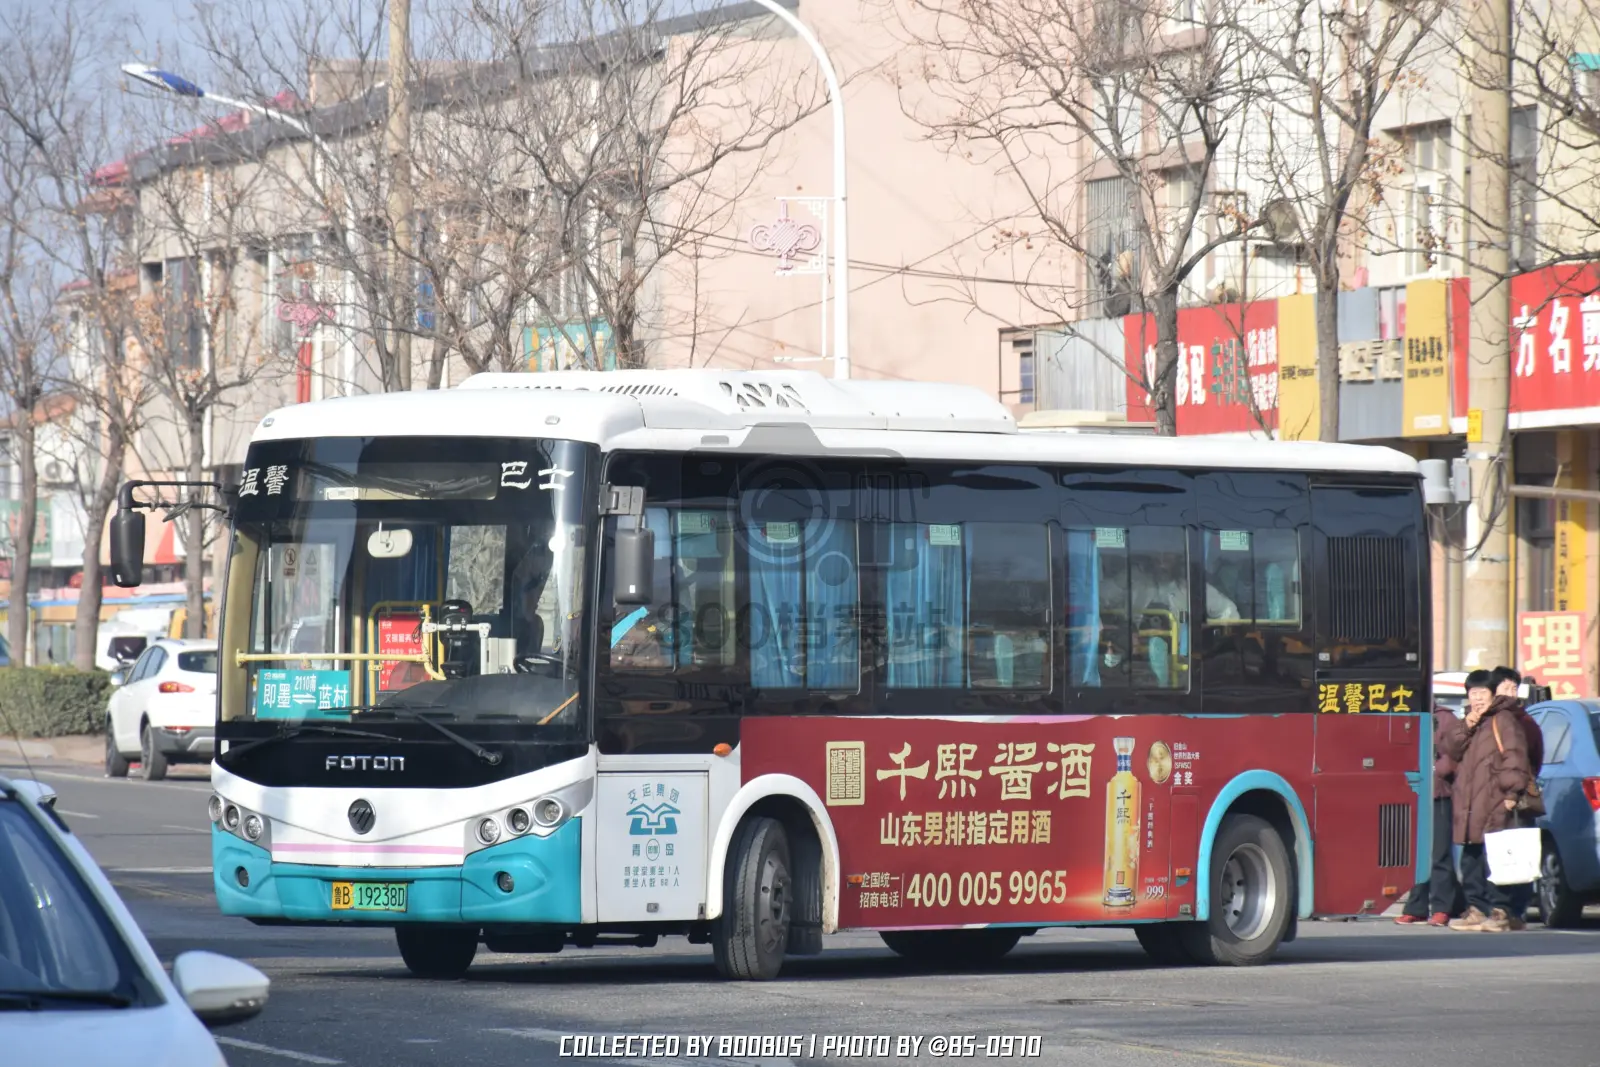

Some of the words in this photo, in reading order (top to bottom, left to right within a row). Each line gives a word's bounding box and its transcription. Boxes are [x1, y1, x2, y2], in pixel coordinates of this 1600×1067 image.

[501, 461, 574, 490] 巴士
[263, 683, 291, 708] 即墨
[318, 684, 348, 709] 蓝村
[1318, 683, 1413, 713] 温馨巴士
[325, 755, 405, 771] FOTON
[876, 742, 1096, 802] 千熙酱酒
[880, 810, 1052, 847] 山东男排指定用酒
[358, 886, 405, 908] 19238D
[859, 890, 900, 909] 招商电话
[906, 872, 952, 908] 400
[958, 871, 1003, 906] 005
[1008, 870, 1068, 905] 9965
